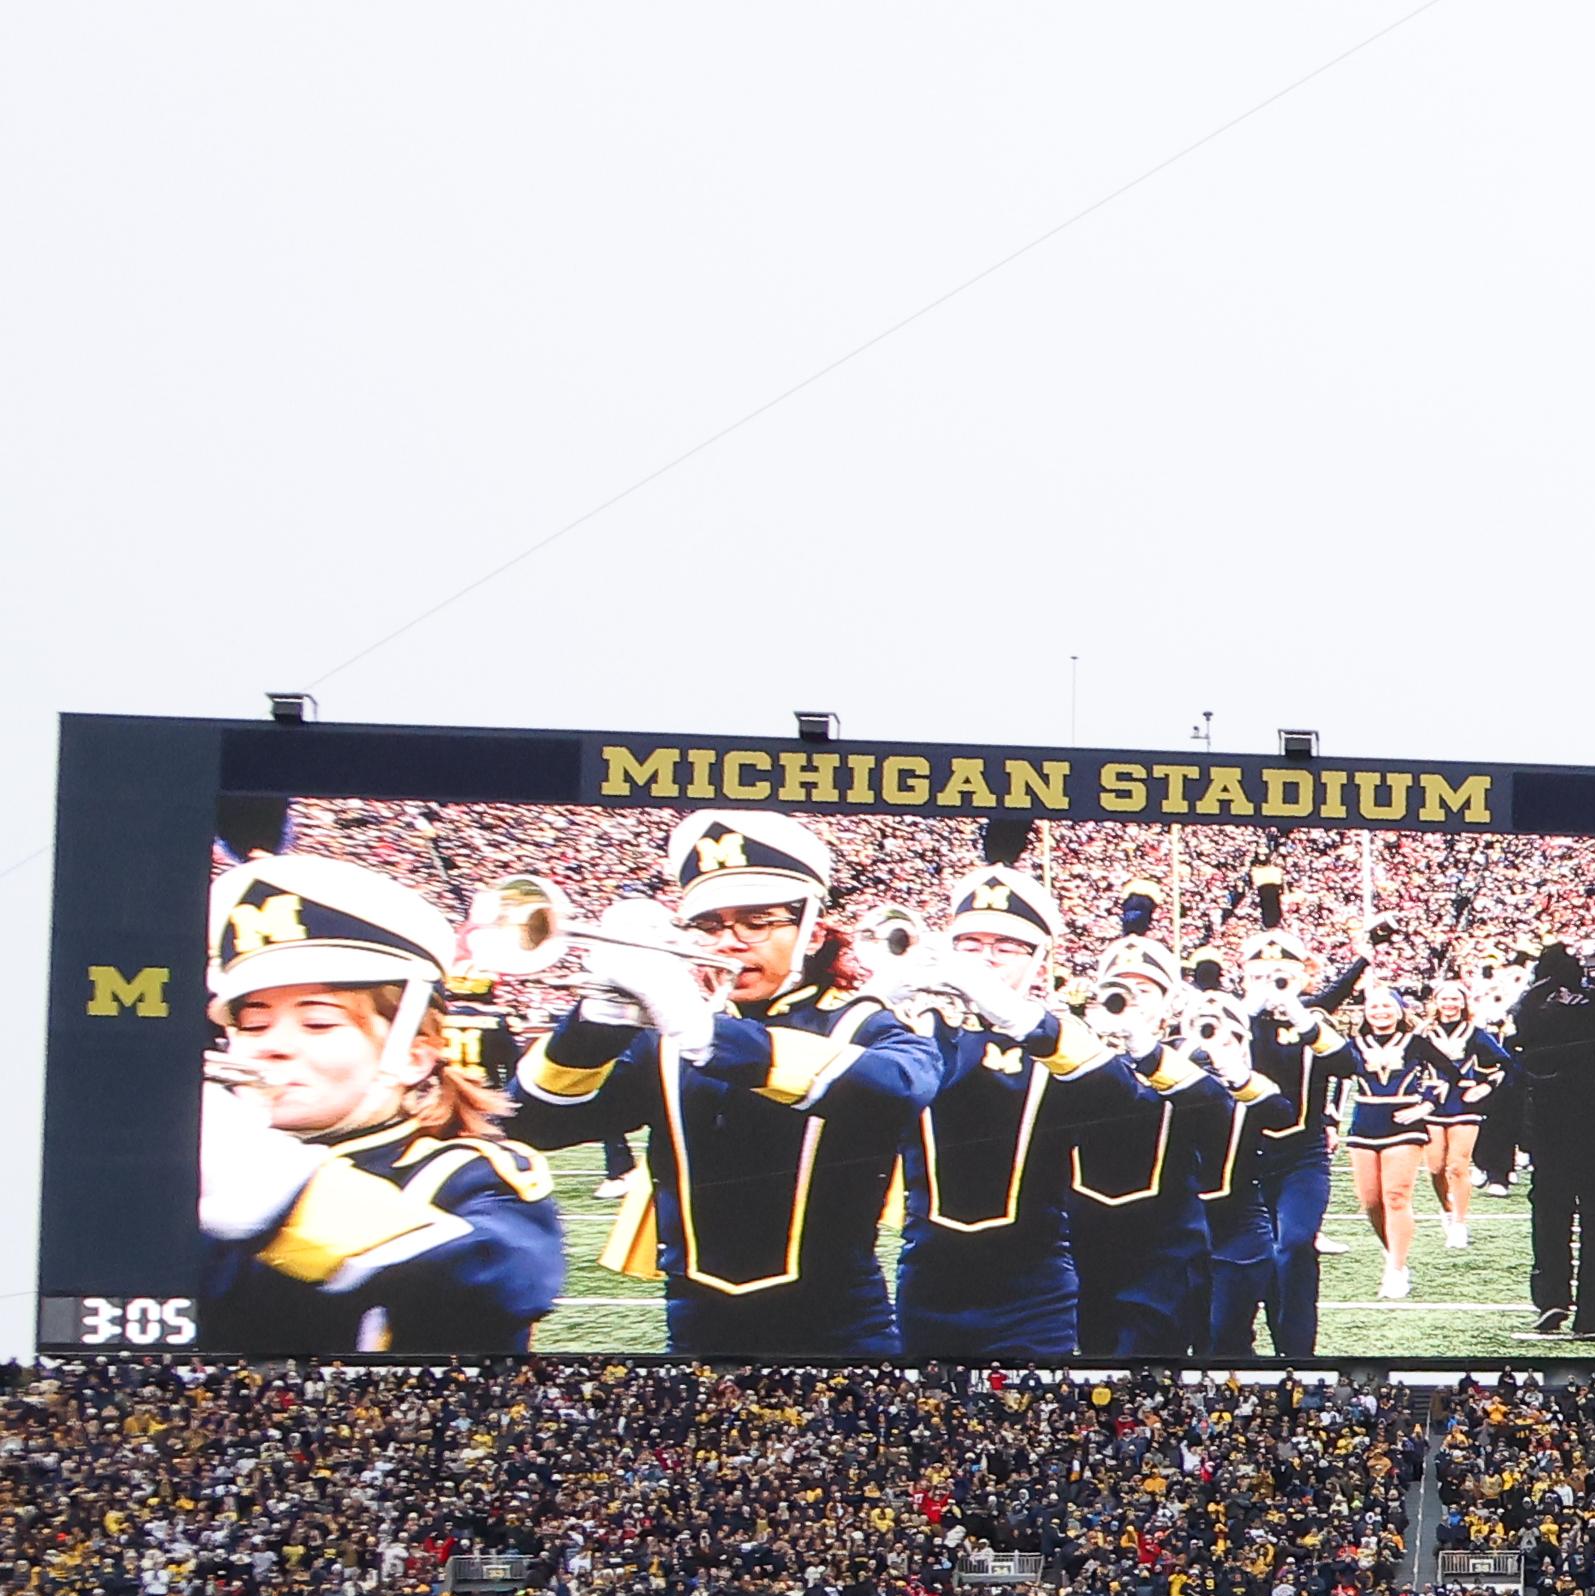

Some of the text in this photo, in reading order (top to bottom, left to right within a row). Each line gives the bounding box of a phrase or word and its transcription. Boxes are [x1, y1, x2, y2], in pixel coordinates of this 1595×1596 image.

[601, 745, 1491, 823] MICHIGAN STADIUM
[87, 966, 170, 1018] M
[82, 1298, 196, 1344] 3:05
